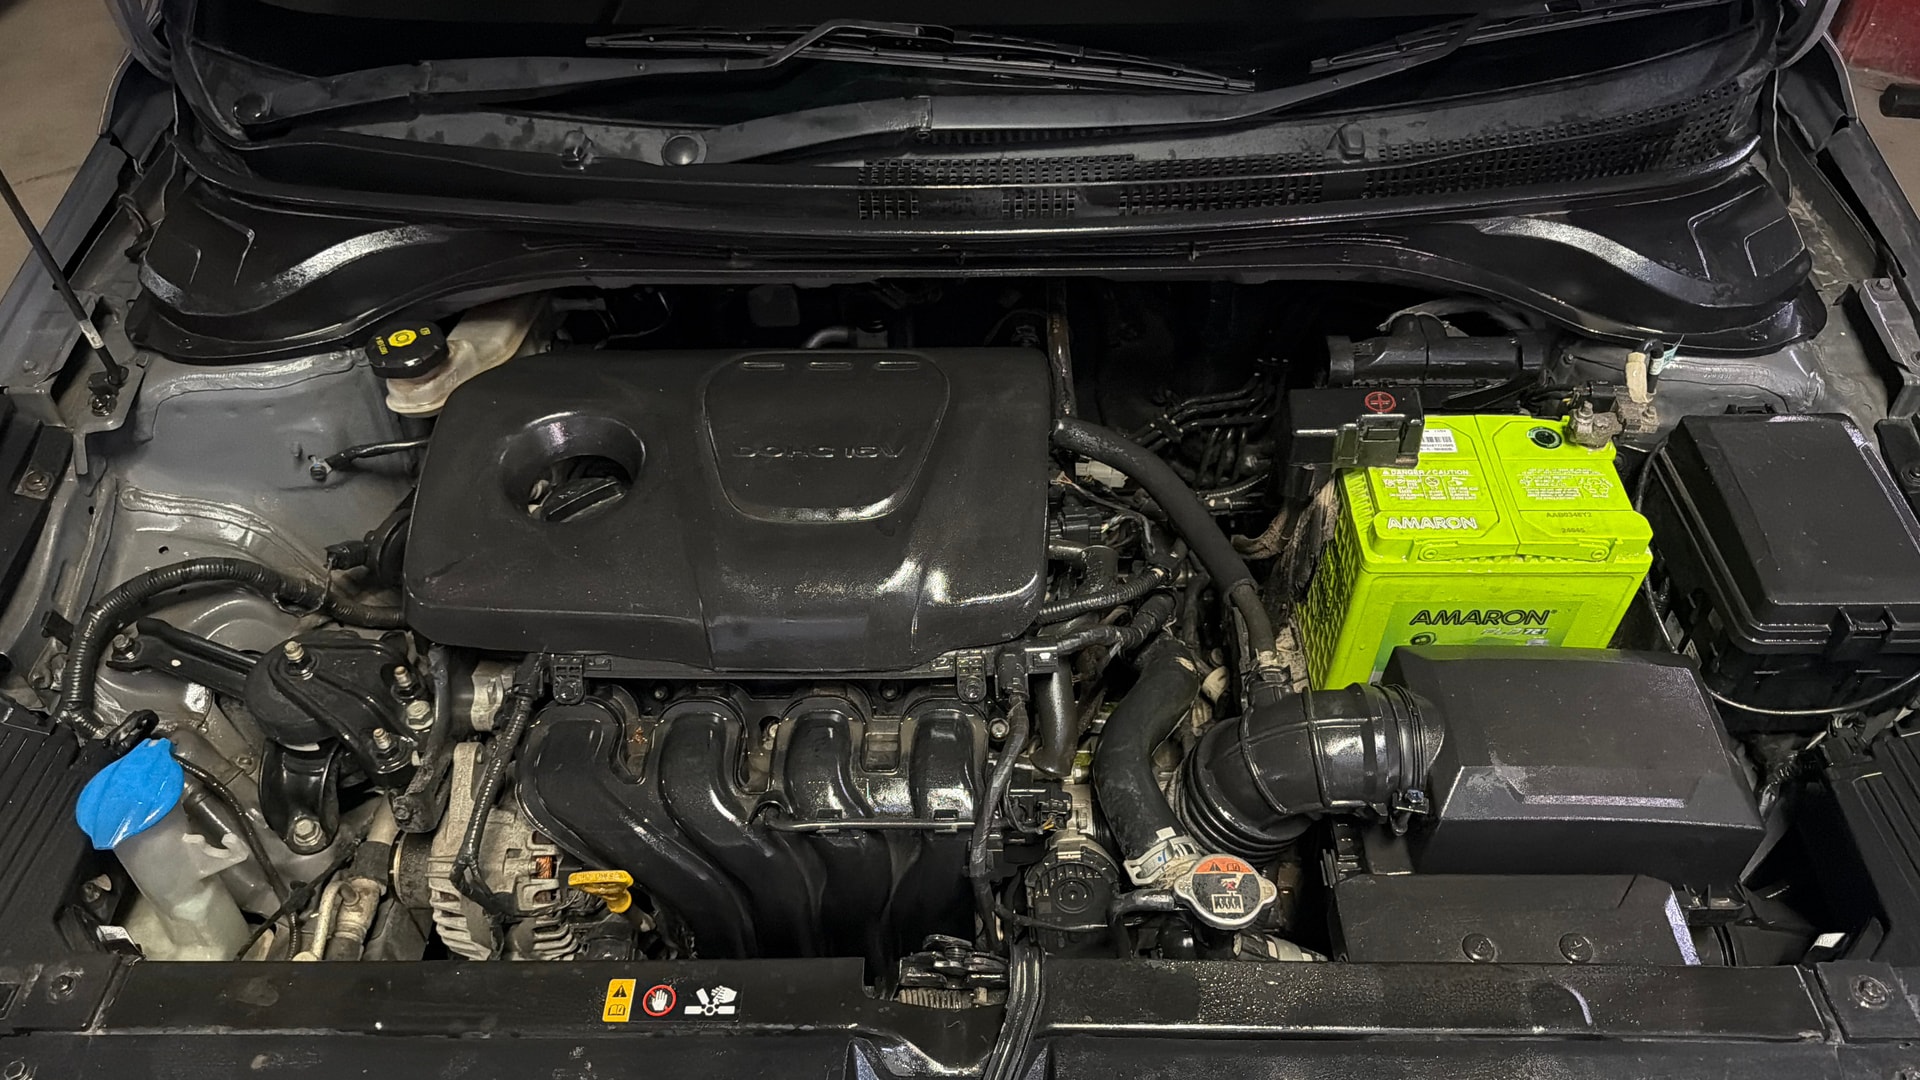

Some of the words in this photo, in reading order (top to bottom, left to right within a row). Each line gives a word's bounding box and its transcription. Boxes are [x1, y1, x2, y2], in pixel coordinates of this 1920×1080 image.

[731, 446, 835, 459] DOHC
[844, 444, 906, 459] 16V
[1387, 516, 1478, 530] AMARON
[1409, 609, 1550, 626] AMARON
